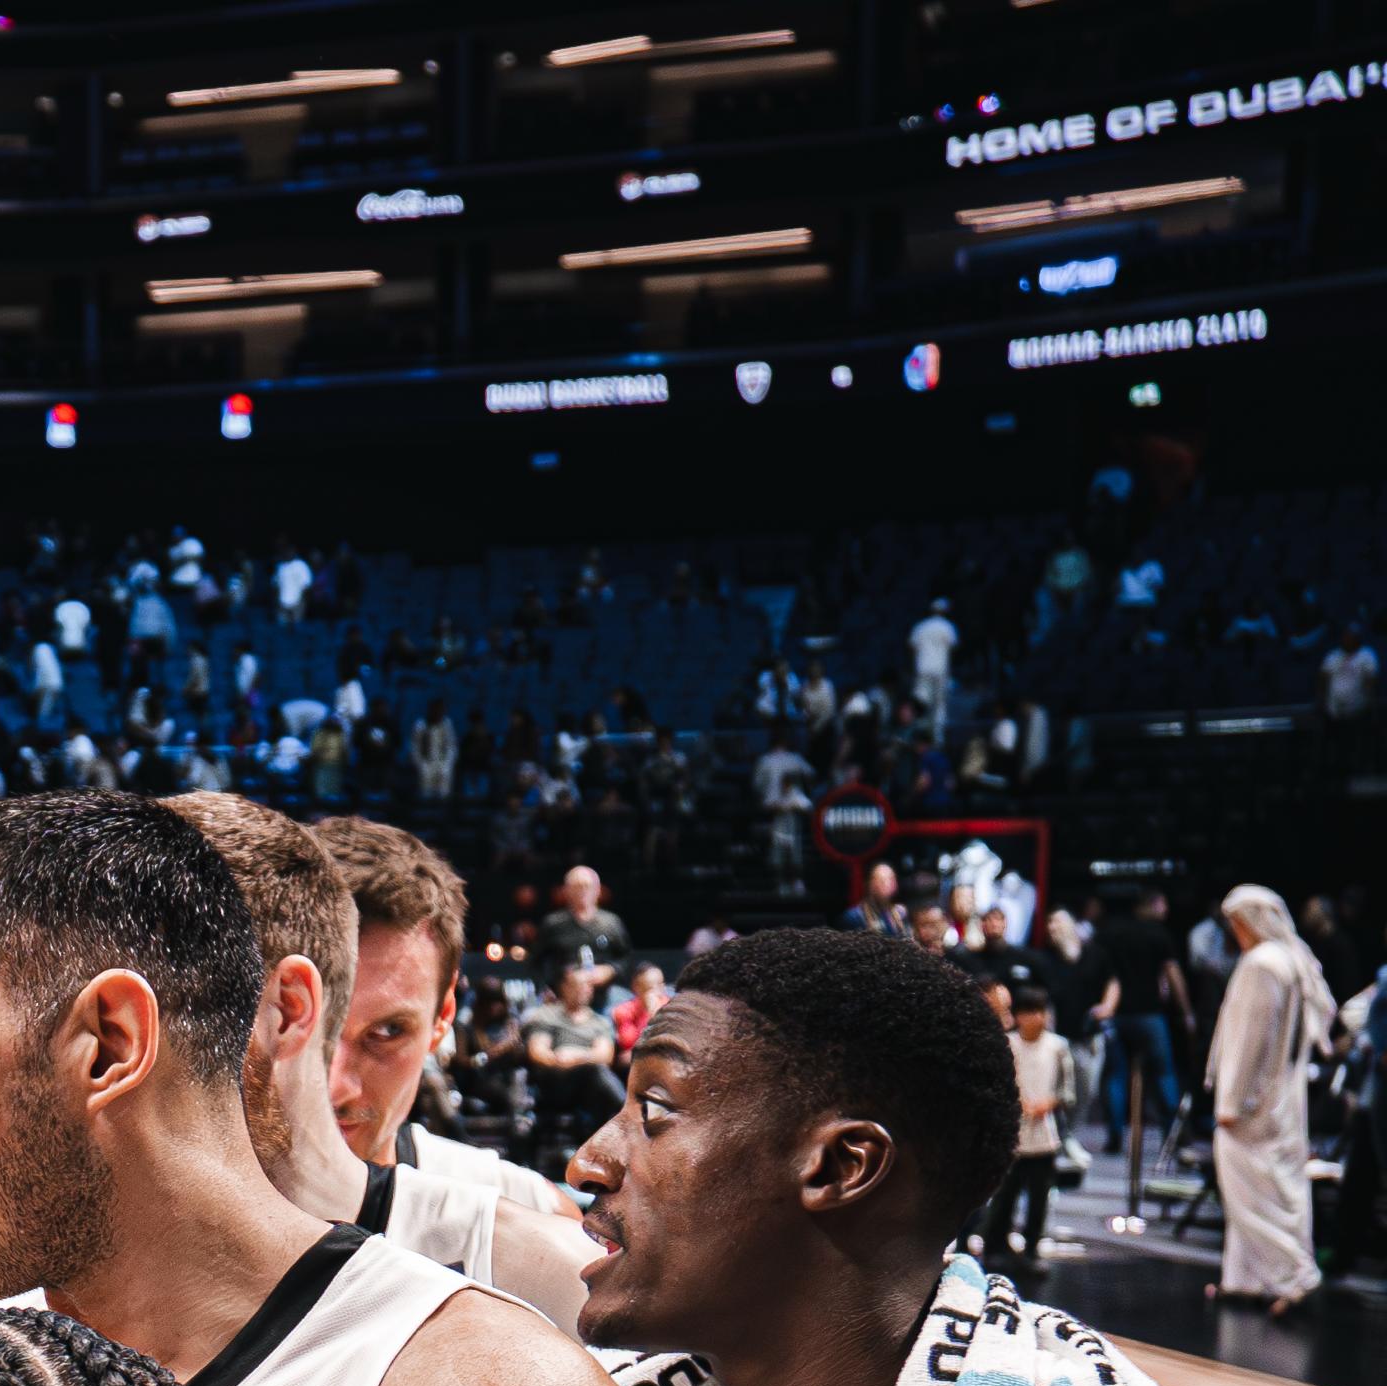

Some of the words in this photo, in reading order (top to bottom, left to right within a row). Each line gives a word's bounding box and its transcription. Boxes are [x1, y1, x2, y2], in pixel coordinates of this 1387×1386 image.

[941, 114, 1095, 168] HOME
[1106, 100, 1177, 141] OF
[1189, 60, 1387, 127] DUBAI'
